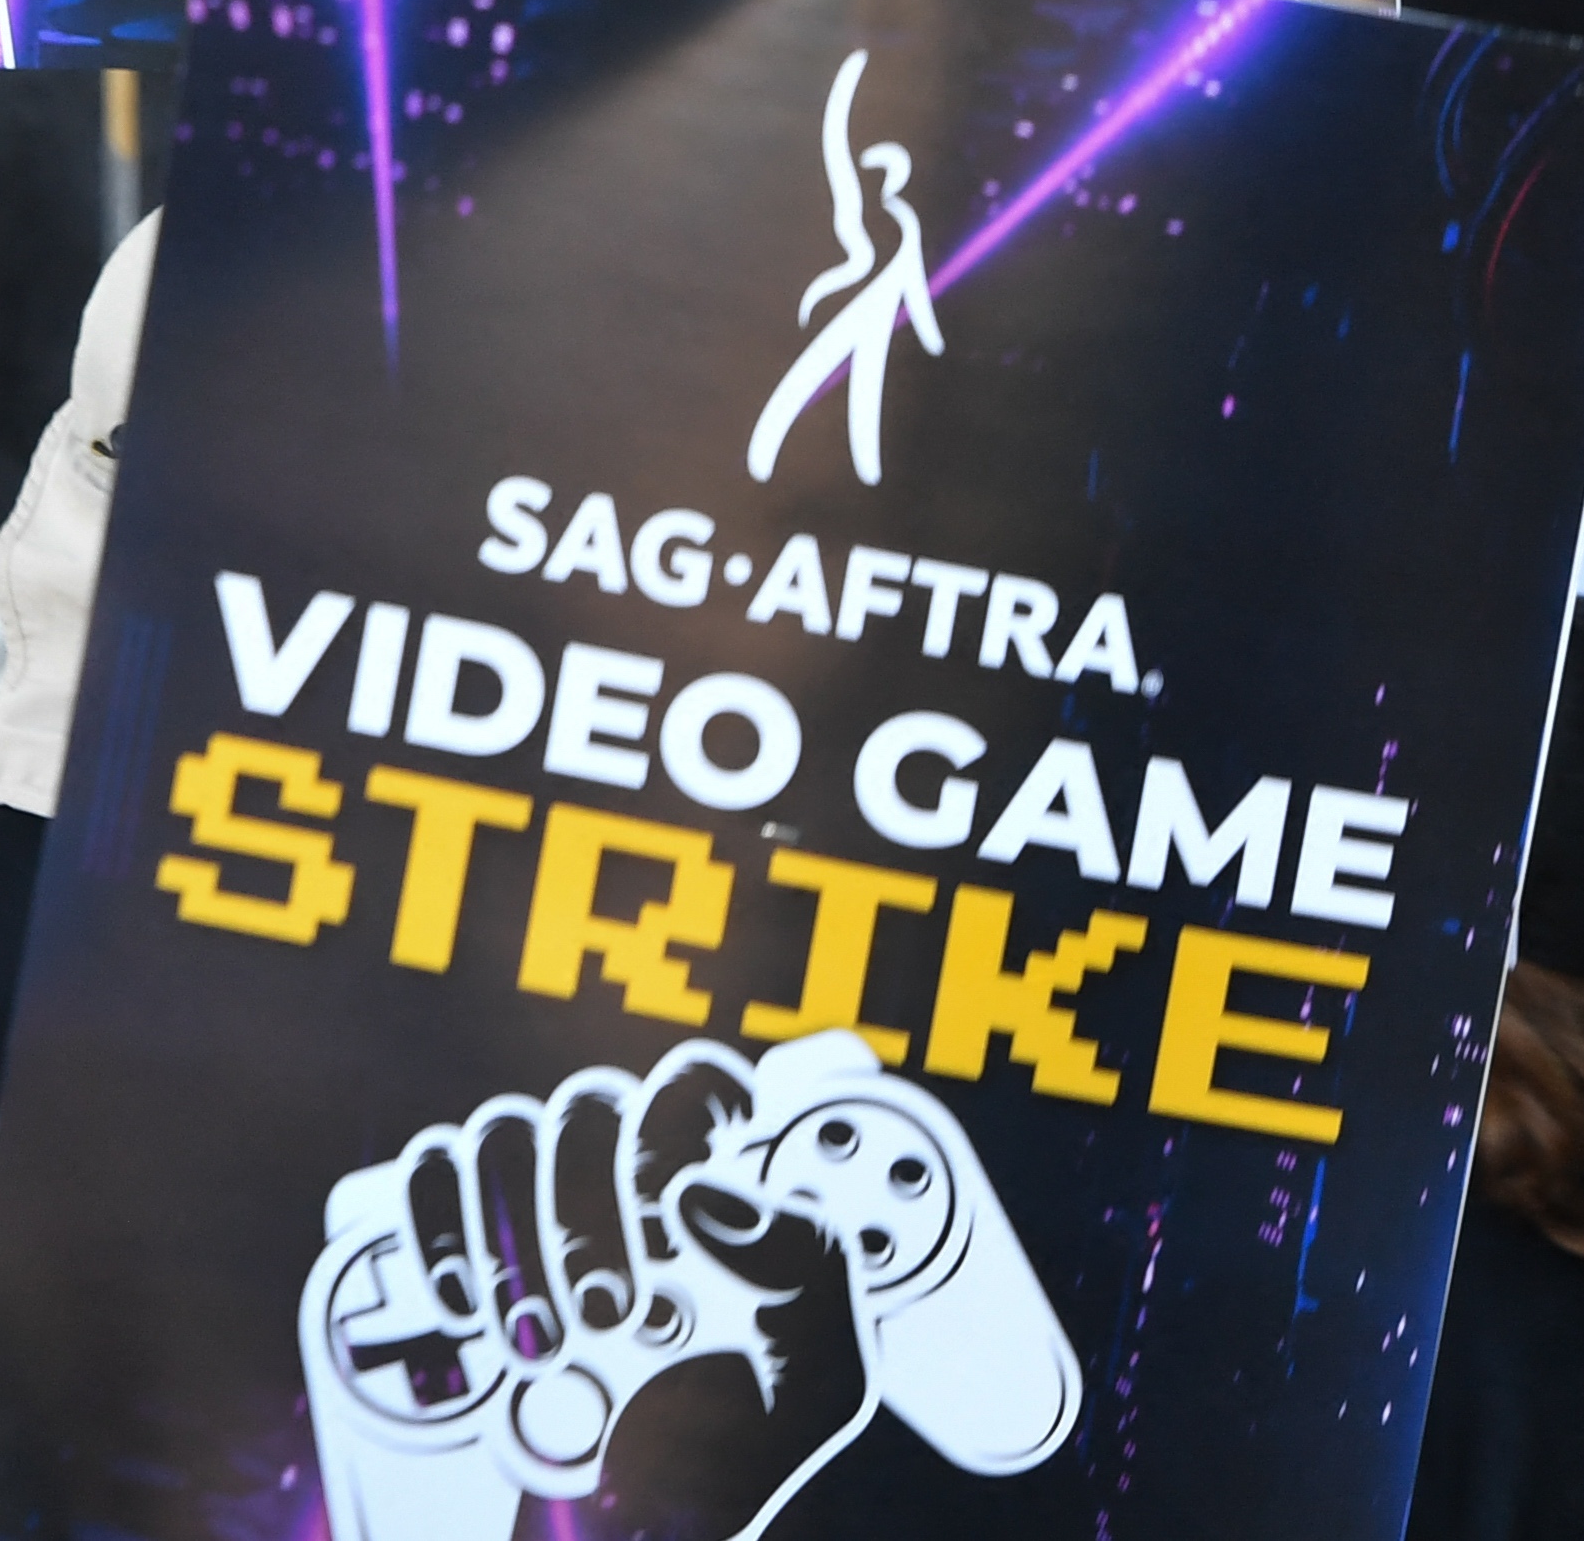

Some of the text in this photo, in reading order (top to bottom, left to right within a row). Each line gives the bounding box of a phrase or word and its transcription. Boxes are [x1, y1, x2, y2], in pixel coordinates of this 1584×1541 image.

[156, 732, 1372, 1145] STRIKE
[214, 571, 1411, 931] VIDEO GAME
